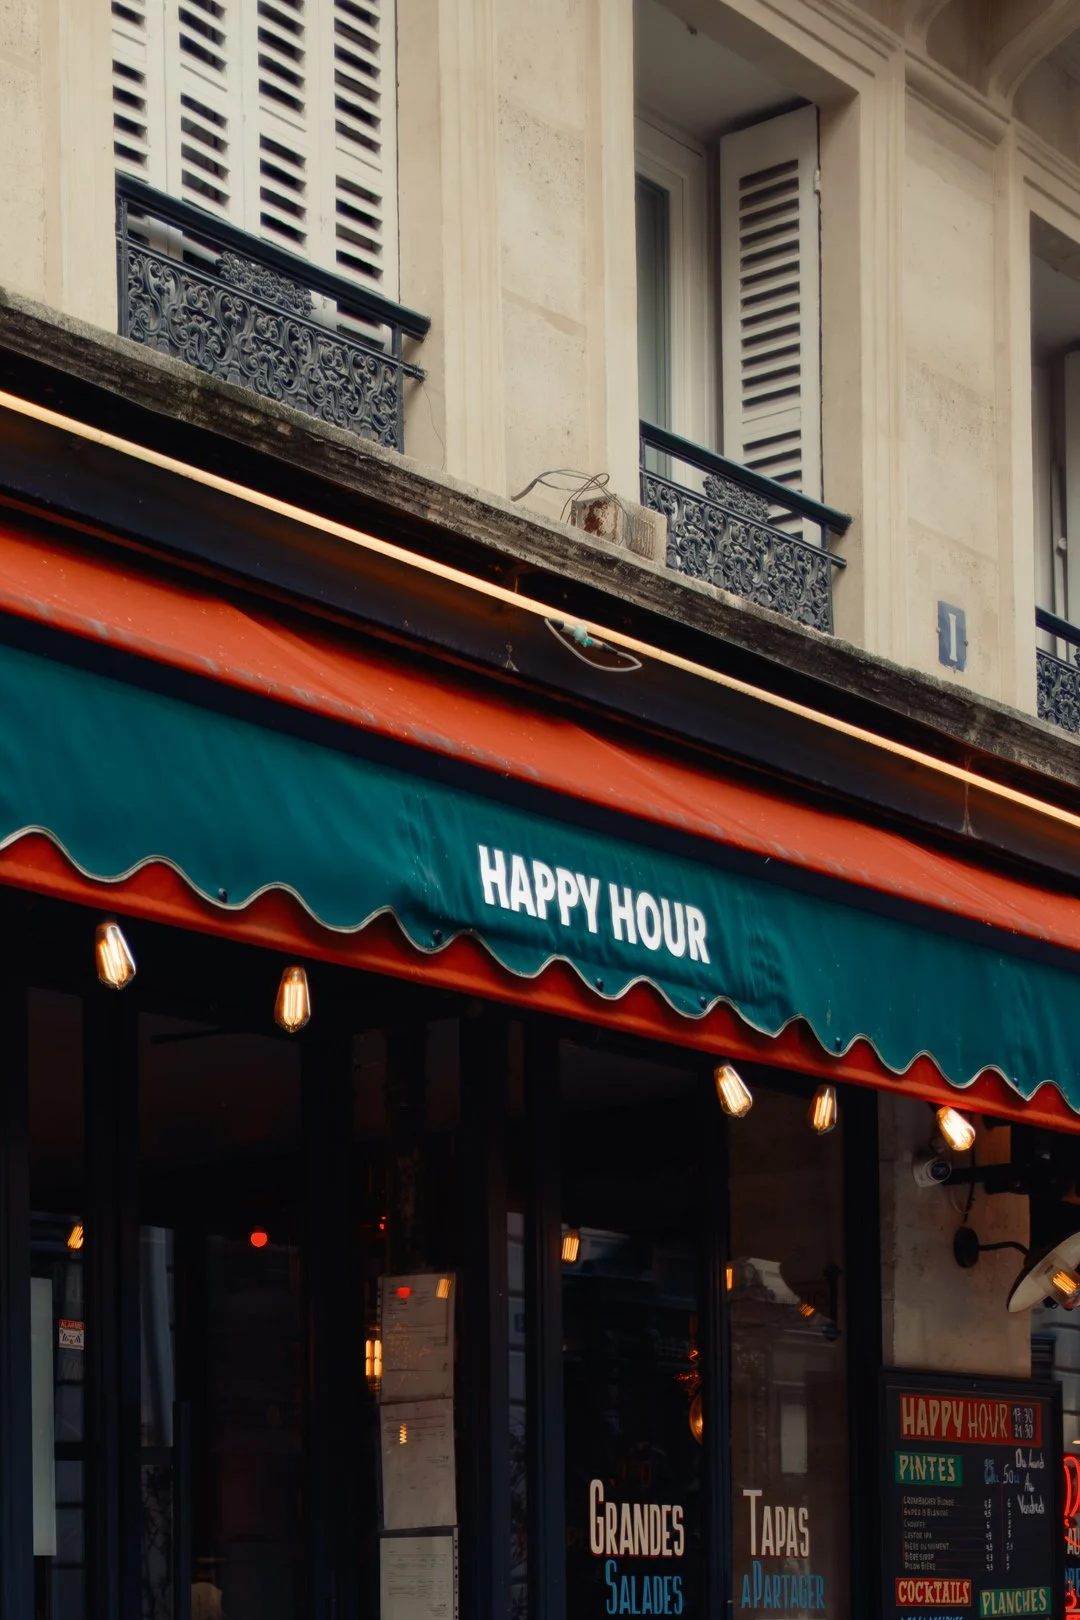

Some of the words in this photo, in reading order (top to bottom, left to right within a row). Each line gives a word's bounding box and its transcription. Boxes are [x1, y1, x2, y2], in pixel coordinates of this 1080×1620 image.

[478, 845, 600, 934] HAPPY
[609, 883, 711, 964] HOUR
[901, 1397, 964, 1437] HAPPY
[968, 1402, 1008, 1438] HOUR
[899, 1455, 956, 1482] PINTES
[589, 1479, 685, 1558] GRANDES
[742, 1489, 810, 1558] TAPAS
[605, 1559, 684, 1615] SALADES
[898, 1580, 970, 1604] COCKTAILS
[981, 1588, 1047, 1616] PLANCHES
